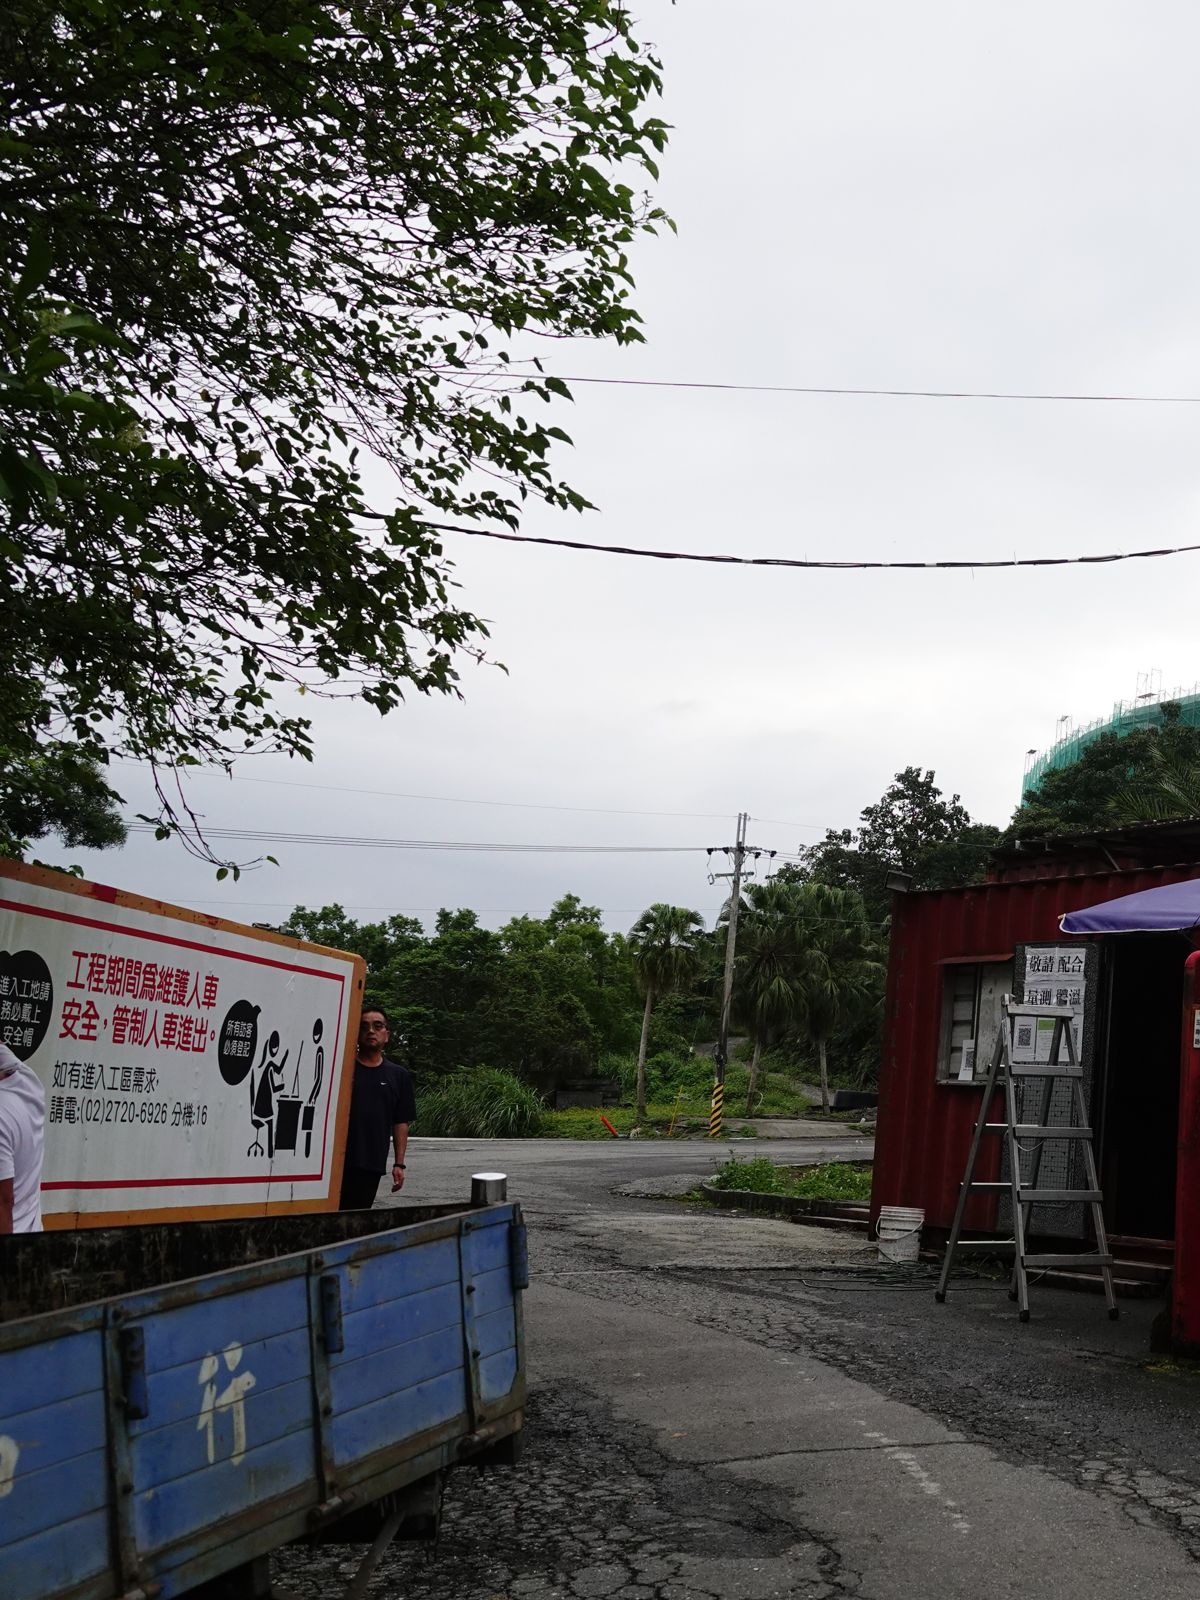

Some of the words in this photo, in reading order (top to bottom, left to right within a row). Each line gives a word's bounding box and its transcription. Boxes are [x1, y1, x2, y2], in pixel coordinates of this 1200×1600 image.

[0, 975, 51, 1001] 進入工地請
[1, 1000, 41, 1024] 務必戴上
[3, 1025, 34, 1047] 安全帽
[226, 1020, 253, 1038] 所有訪客
[223, 1039, 251, 1057] 必須登記
